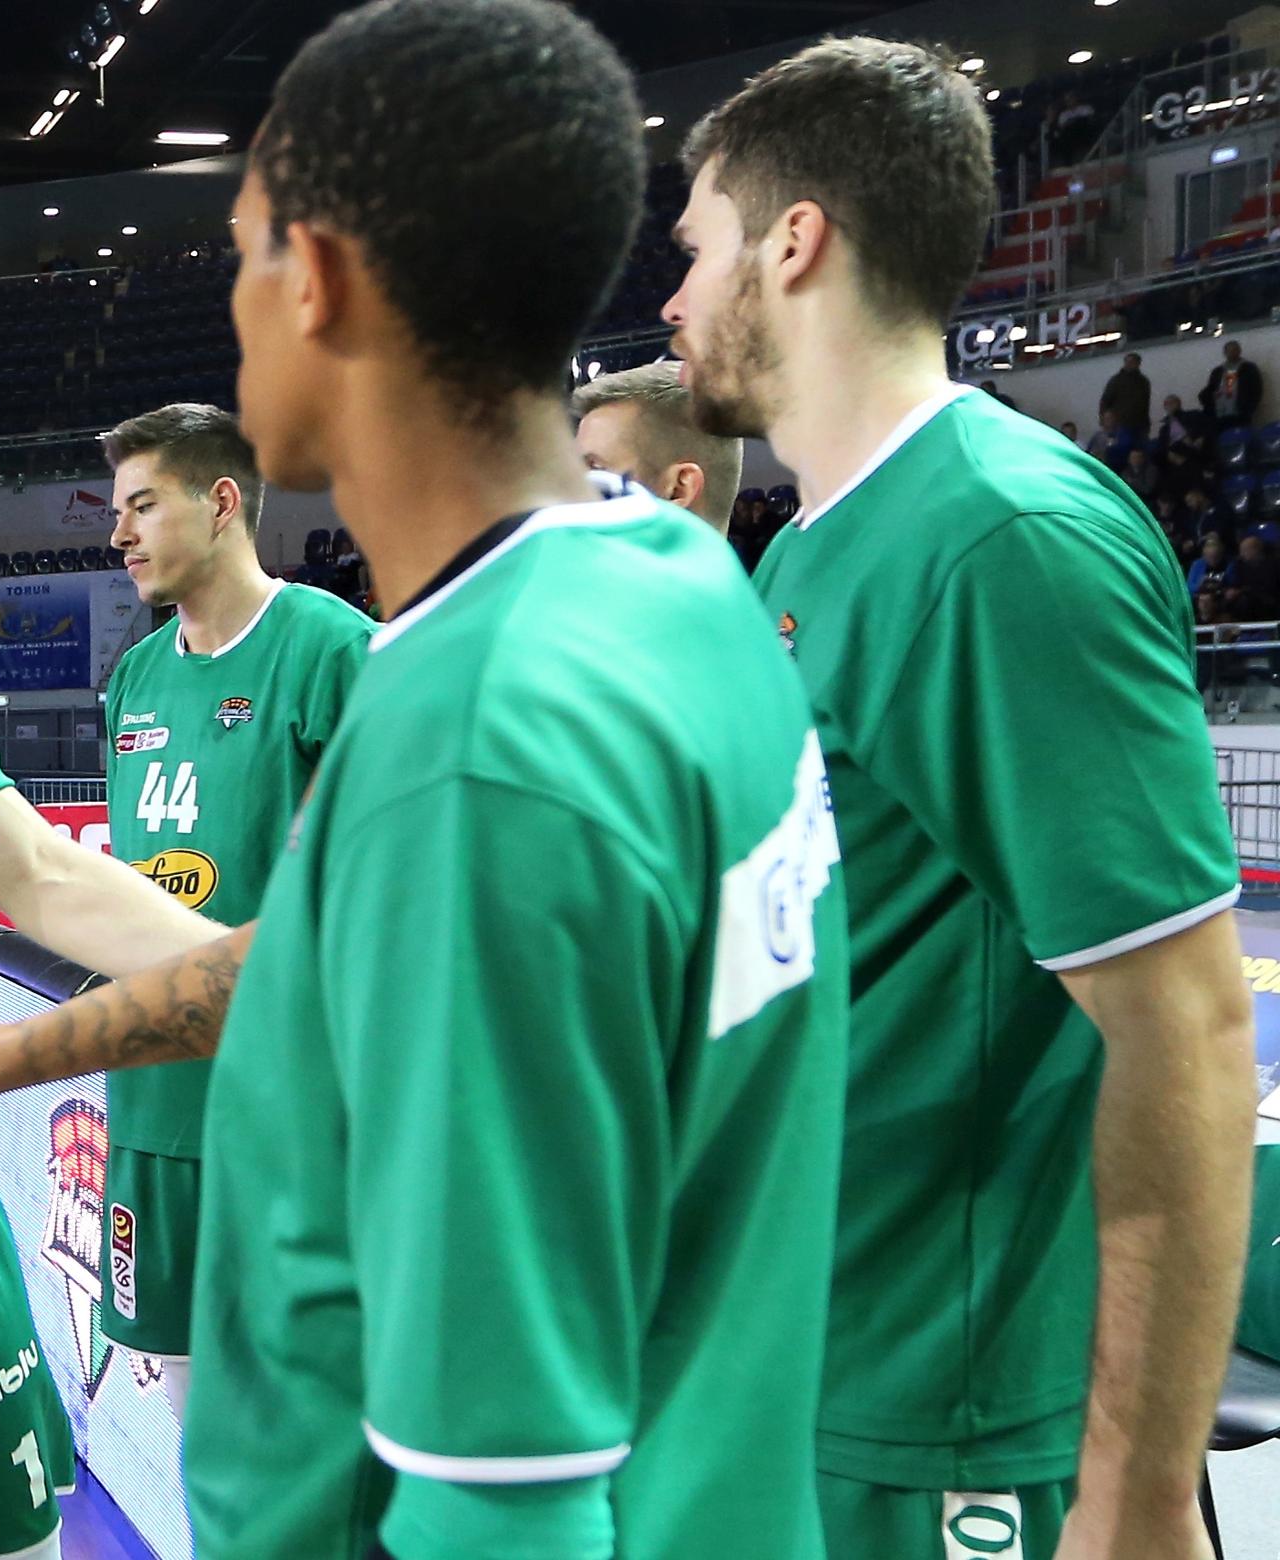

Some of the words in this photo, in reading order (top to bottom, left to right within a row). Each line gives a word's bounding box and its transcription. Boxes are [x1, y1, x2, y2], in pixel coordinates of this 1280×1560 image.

[956, 316, 1014, 362] G2
[1040, 303, 1090, 346] H2
[121, 711, 156, 726] SPALDING
[136, 761, 200, 834] 44
[10, 1429, 49, 1511] 1
